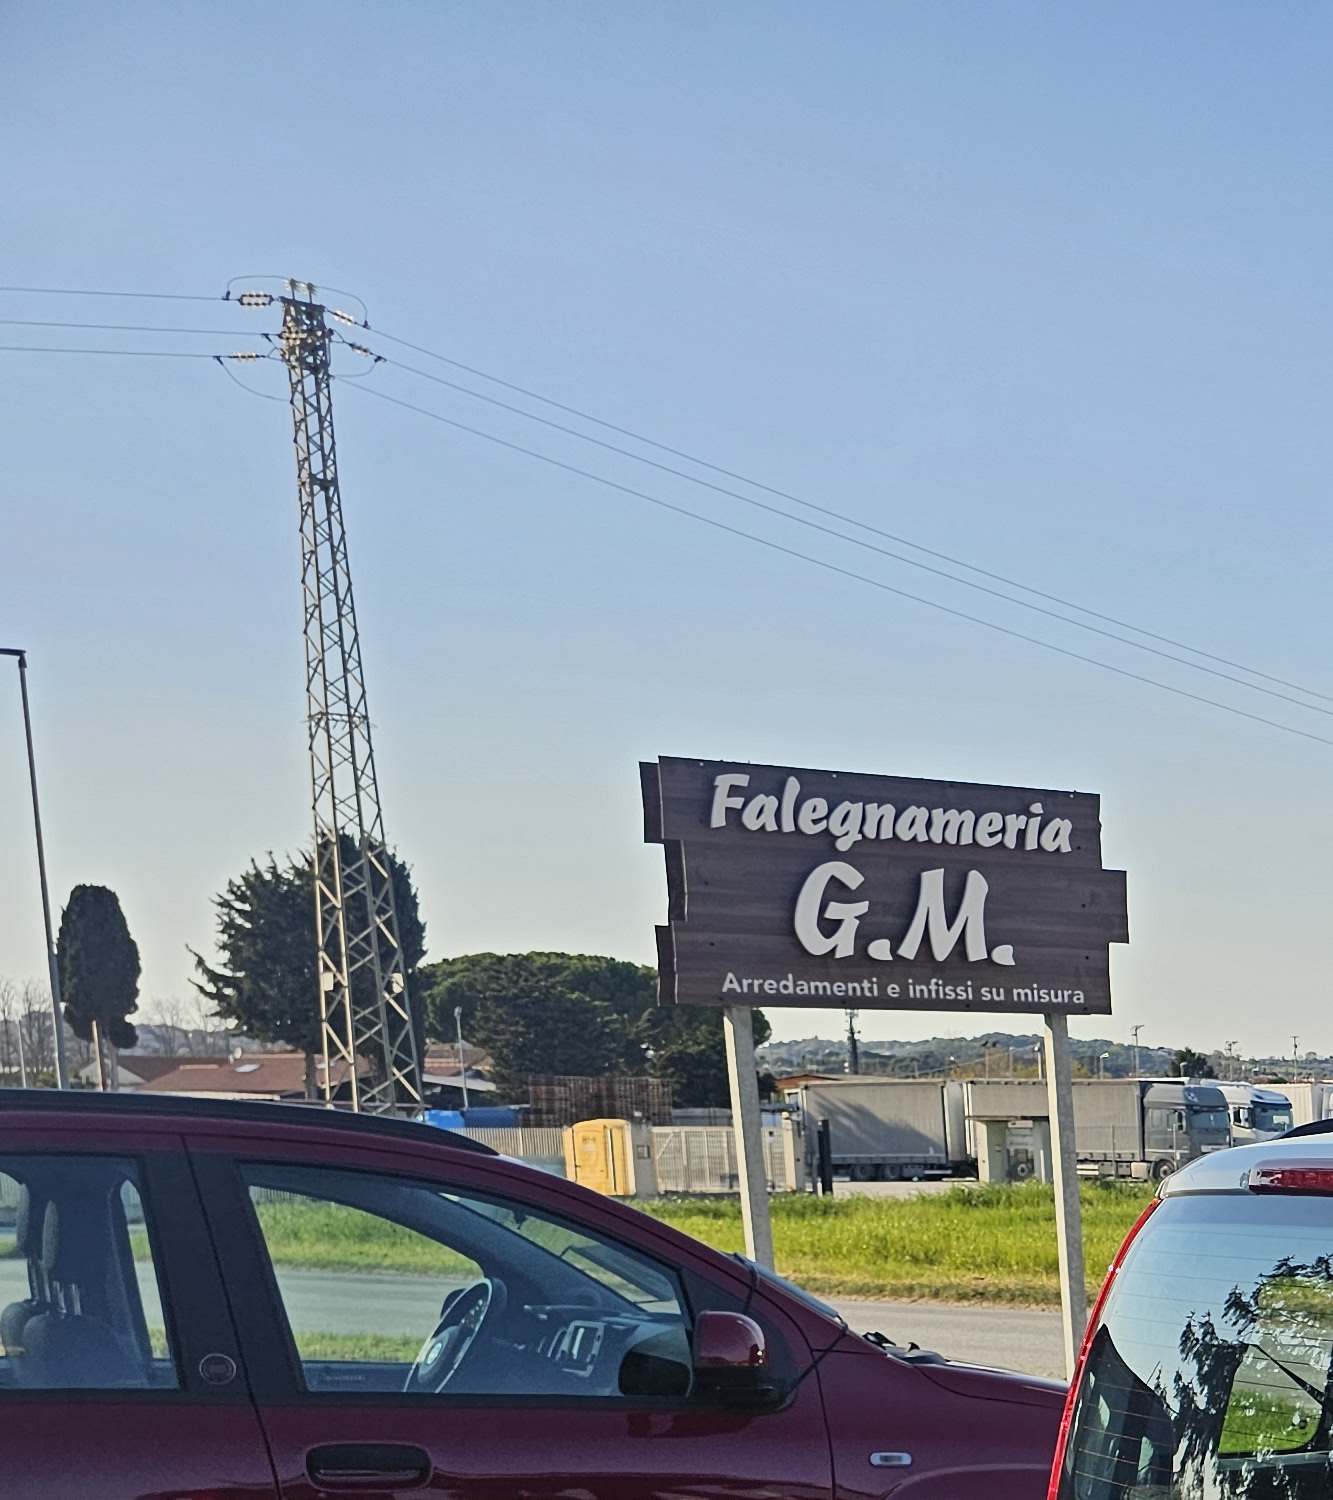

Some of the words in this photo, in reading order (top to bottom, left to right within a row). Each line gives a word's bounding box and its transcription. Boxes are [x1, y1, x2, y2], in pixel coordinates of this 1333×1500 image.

[710, 773, 1074, 853] Falegnameria
[793, 860, 1016, 966] G.M.
[721, 970, 879, 999] Arredamenti
[886, 982, 901, 998] e
[908, 977, 973, 1002] infissi
[980, 984, 1006, 1002] su
[1013, 981, 1086, 1004] misura
